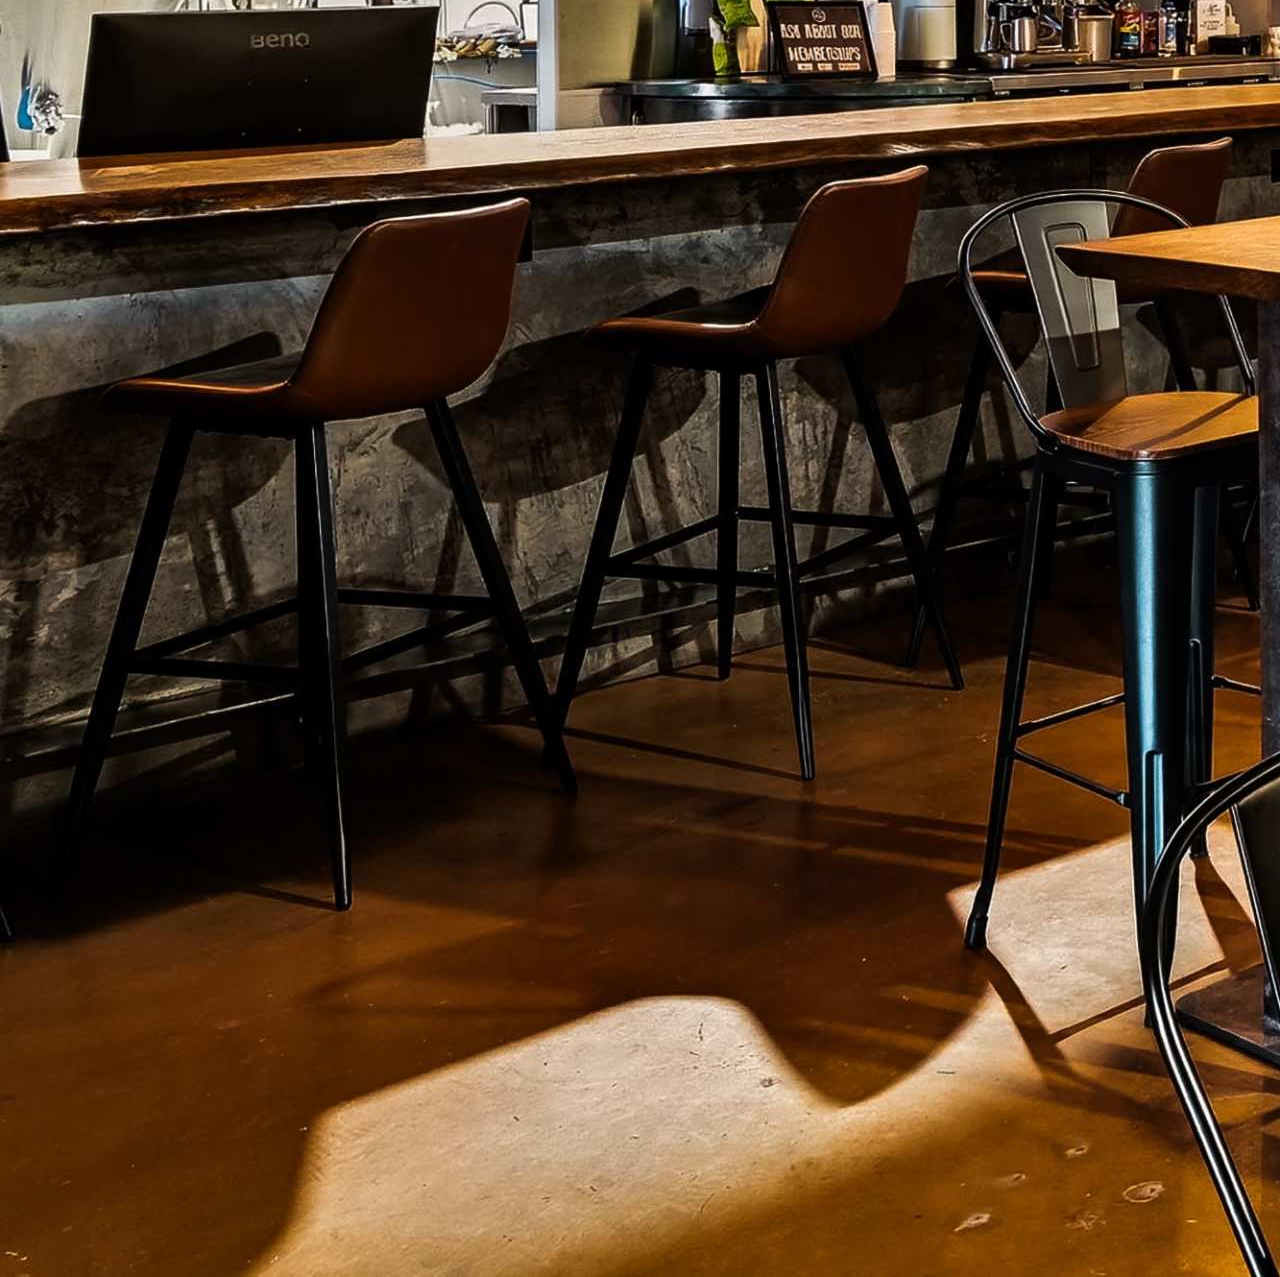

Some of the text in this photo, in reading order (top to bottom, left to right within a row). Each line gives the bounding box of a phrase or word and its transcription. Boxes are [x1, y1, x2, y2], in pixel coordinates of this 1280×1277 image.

[780, 24, 801, 39] ASK
[804, 24, 837, 39] ABOUT
[250, 32, 311, 50] BenQ
[788, 46, 861, 62] MEMBERSHIPS
